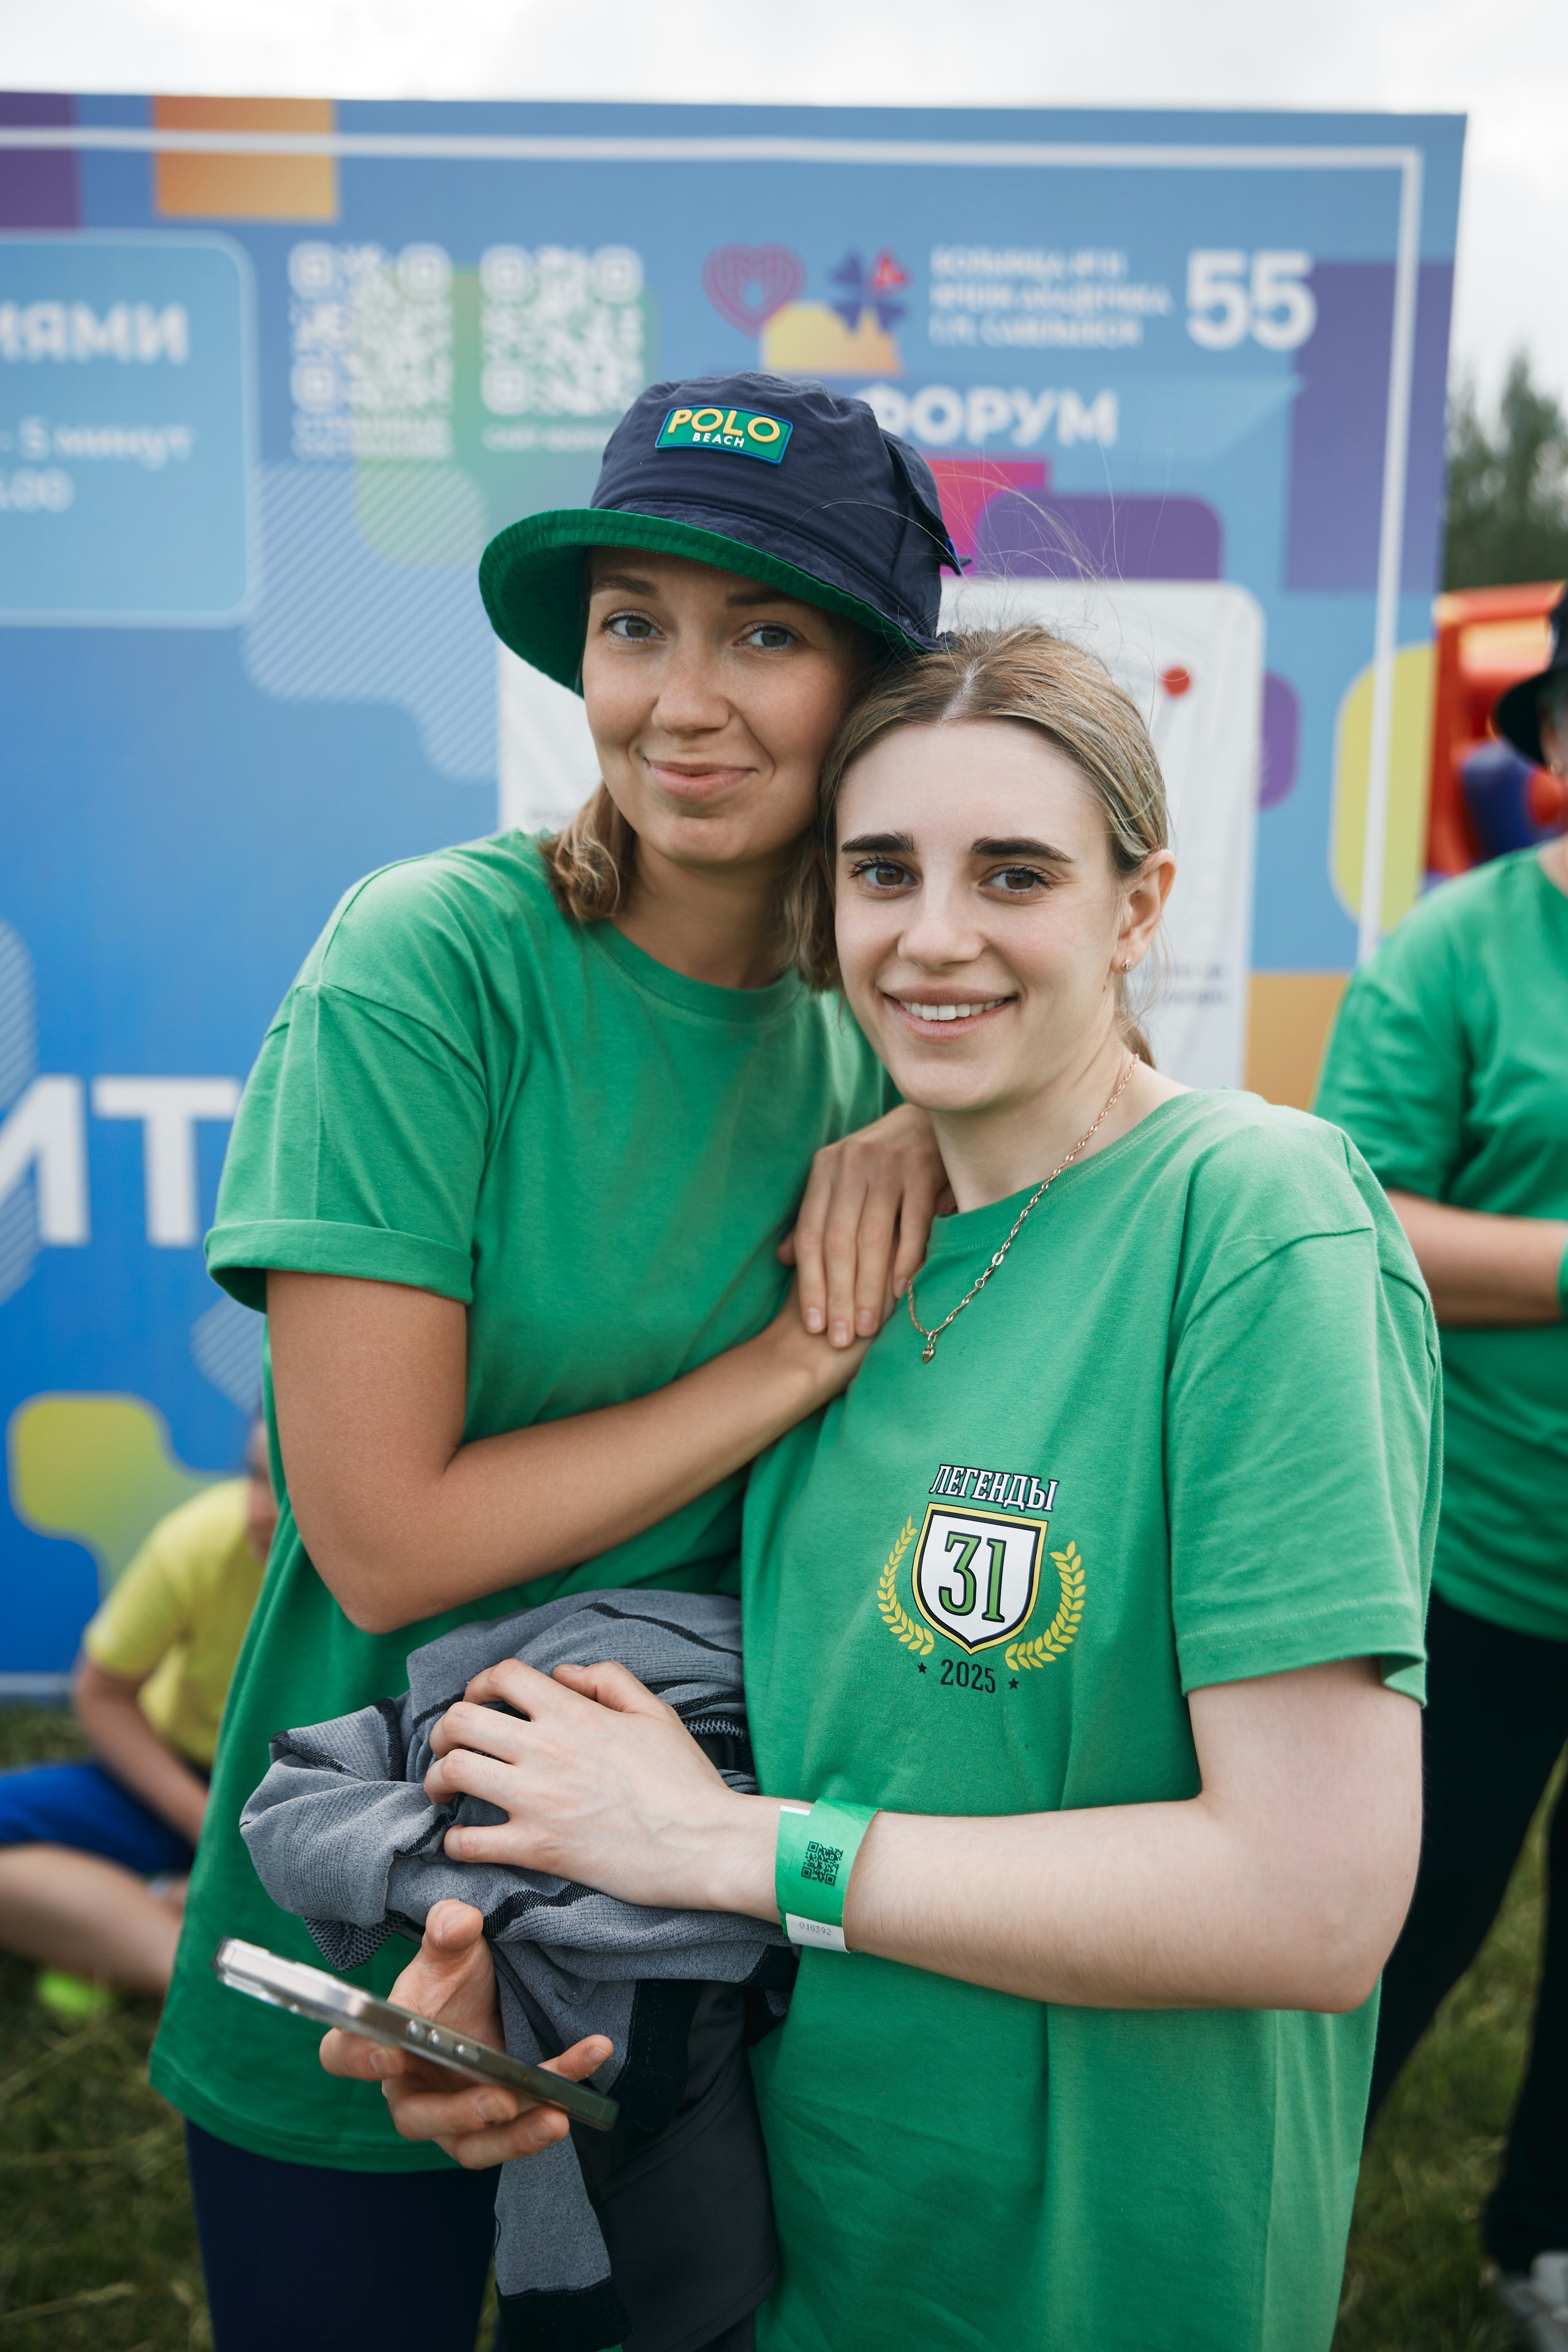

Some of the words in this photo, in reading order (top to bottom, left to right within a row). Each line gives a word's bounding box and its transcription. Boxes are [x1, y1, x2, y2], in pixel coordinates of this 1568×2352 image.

[1186, 251, 1318, 349] 55
[668, 408, 780, 443] POLO
[692, 432, 745, 448] BEACH
[929, 1463, 1059, 1512] ЛЕГЕНДЫ
[938, 1530, 1007, 1623] 31
[940, 1659, 996, 1694] 2025
[799, 1921, 832, 1936] 010392
